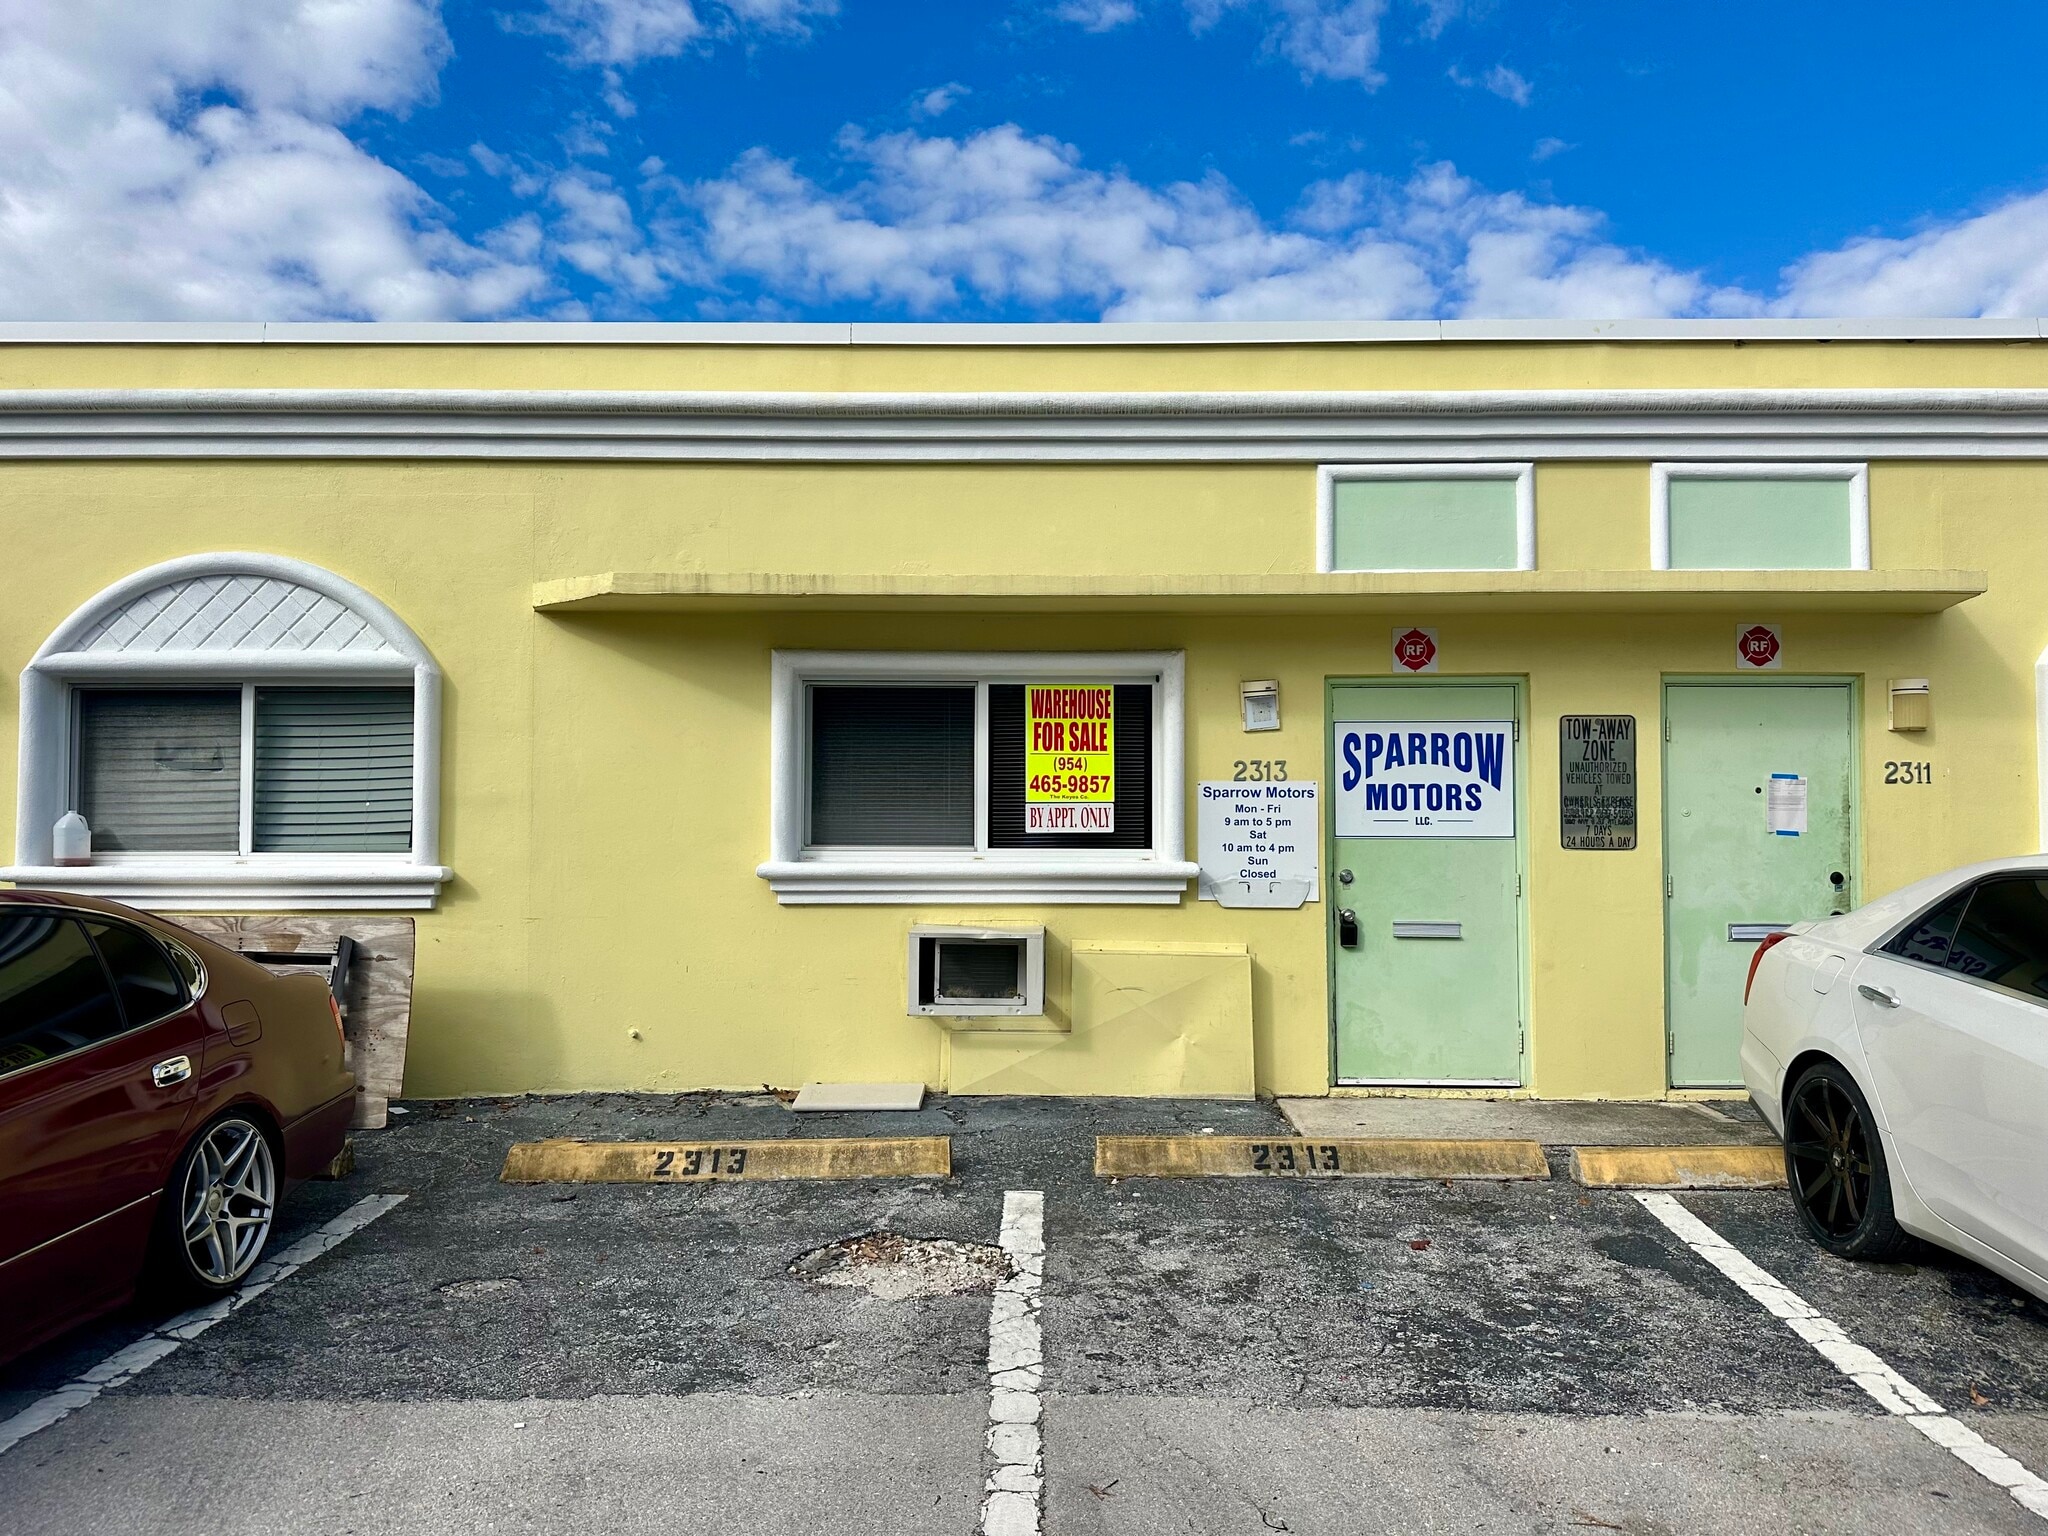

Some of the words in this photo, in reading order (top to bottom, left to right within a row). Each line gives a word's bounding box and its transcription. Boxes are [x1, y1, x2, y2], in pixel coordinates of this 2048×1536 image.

[1405, 644, 1424, 656] RF
[1750, 640, 1768, 652] RF
[1031, 689, 1111, 719] WAREHOUSE
[1566, 718, 1631, 740] TOW-AWAY
[1033, 722, 1064, 752] FOR
[1069, 722, 1108, 752] SALE
[1582, 740, 1616, 761] ZONE
[1053, 757, 1088, 772] (954)
[1342, 732, 1505, 792] SPARROW
[1569, 762, 1627, 773] UNAUTHORIZED
[1233, 760, 1288, 782] 2313
[1884, 761, 1932, 784] 2311
[1030, 775, 1111, 793] 465-9857
[1566, 773, 1602, 784] VEHICLES
[1606, 773, 1631, 784] TOWED
[1203, 786, 1262, 800] Sparrow
[1266, 786, 1315, 798] Motors
[1594, 785, 1604, 795] AT
[1365, 783, 1482, 811] MOTORS
[1235, 804, 1257, 813] Mon
[1267, 804, 1281, 813] Fri
[1030, 807, 1044, 828] BY
[1047, 807, 1077, 828] APPT.
[1081, 807, 1111, 828] ONLY
[1224, 817, 1231, 826] 9
[1252, 818, 1263, 826] to
[1266, 817, 1272, 826] 5
[1275, 819, 1292, 828] pm
[1415, 816, 1433, 826] LLC.
[1249, 830, 1267, 839] Sat
[1586, 825, 1590, 836] 7
[1594, 825, 1612, 836] DAYS
[1566, 836, 1576, 847] 24
[1609, 837, 1614, 847] A
[1618, 837, 1632, 847] DAY
[1222, 843, 1234, 852] 10
[1256, 844, 1266, 852] to
[1269, 843, 1275, 852] 4
[1278, 845, 1295, 854] pm
[1247, 856, 1269, 865] Sun
[1240, 869, 1277, 879] Closed
[653, 1148, 747, 1175] 2313
[1252, 1145, 1340, 1170] 2313
